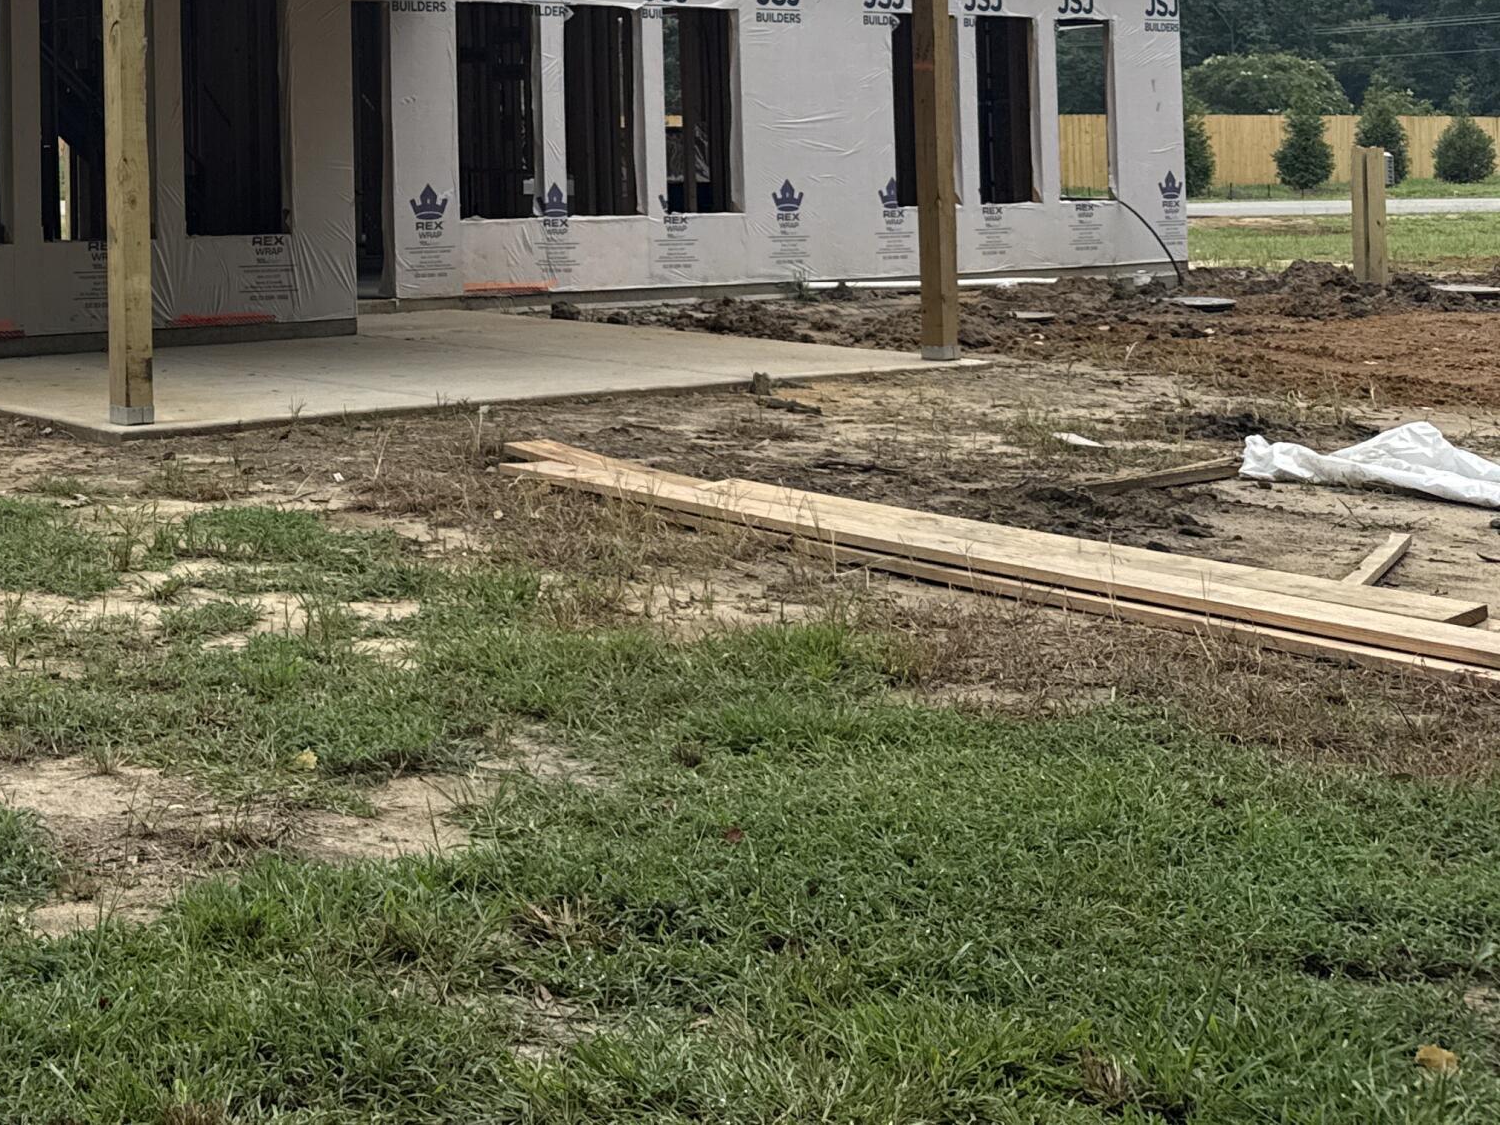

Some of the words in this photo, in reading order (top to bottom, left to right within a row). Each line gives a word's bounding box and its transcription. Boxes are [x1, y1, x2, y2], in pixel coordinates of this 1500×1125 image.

[392, 0, 447, 12] BUILDERS
[642, 8, 663, 19] BUIL
[756, 12, 801, 23] BUILDERS
[1144, 23, 1180, 33] BUILDERS
[1162, 200, 1180, 208] REX
[776, 213, 800, 221] REX
[883, 210, 904, 218] REX
[543, 219, 568, 227] REX
[663, 216, 688, 224] REX
[416, 221, 443, 230] REX
[252, 236, 284, 246] REX
[88, 242, 107, 252] RE
[255, 247, 283, 256] WRAP
[91, 253, 107, 262] WR
